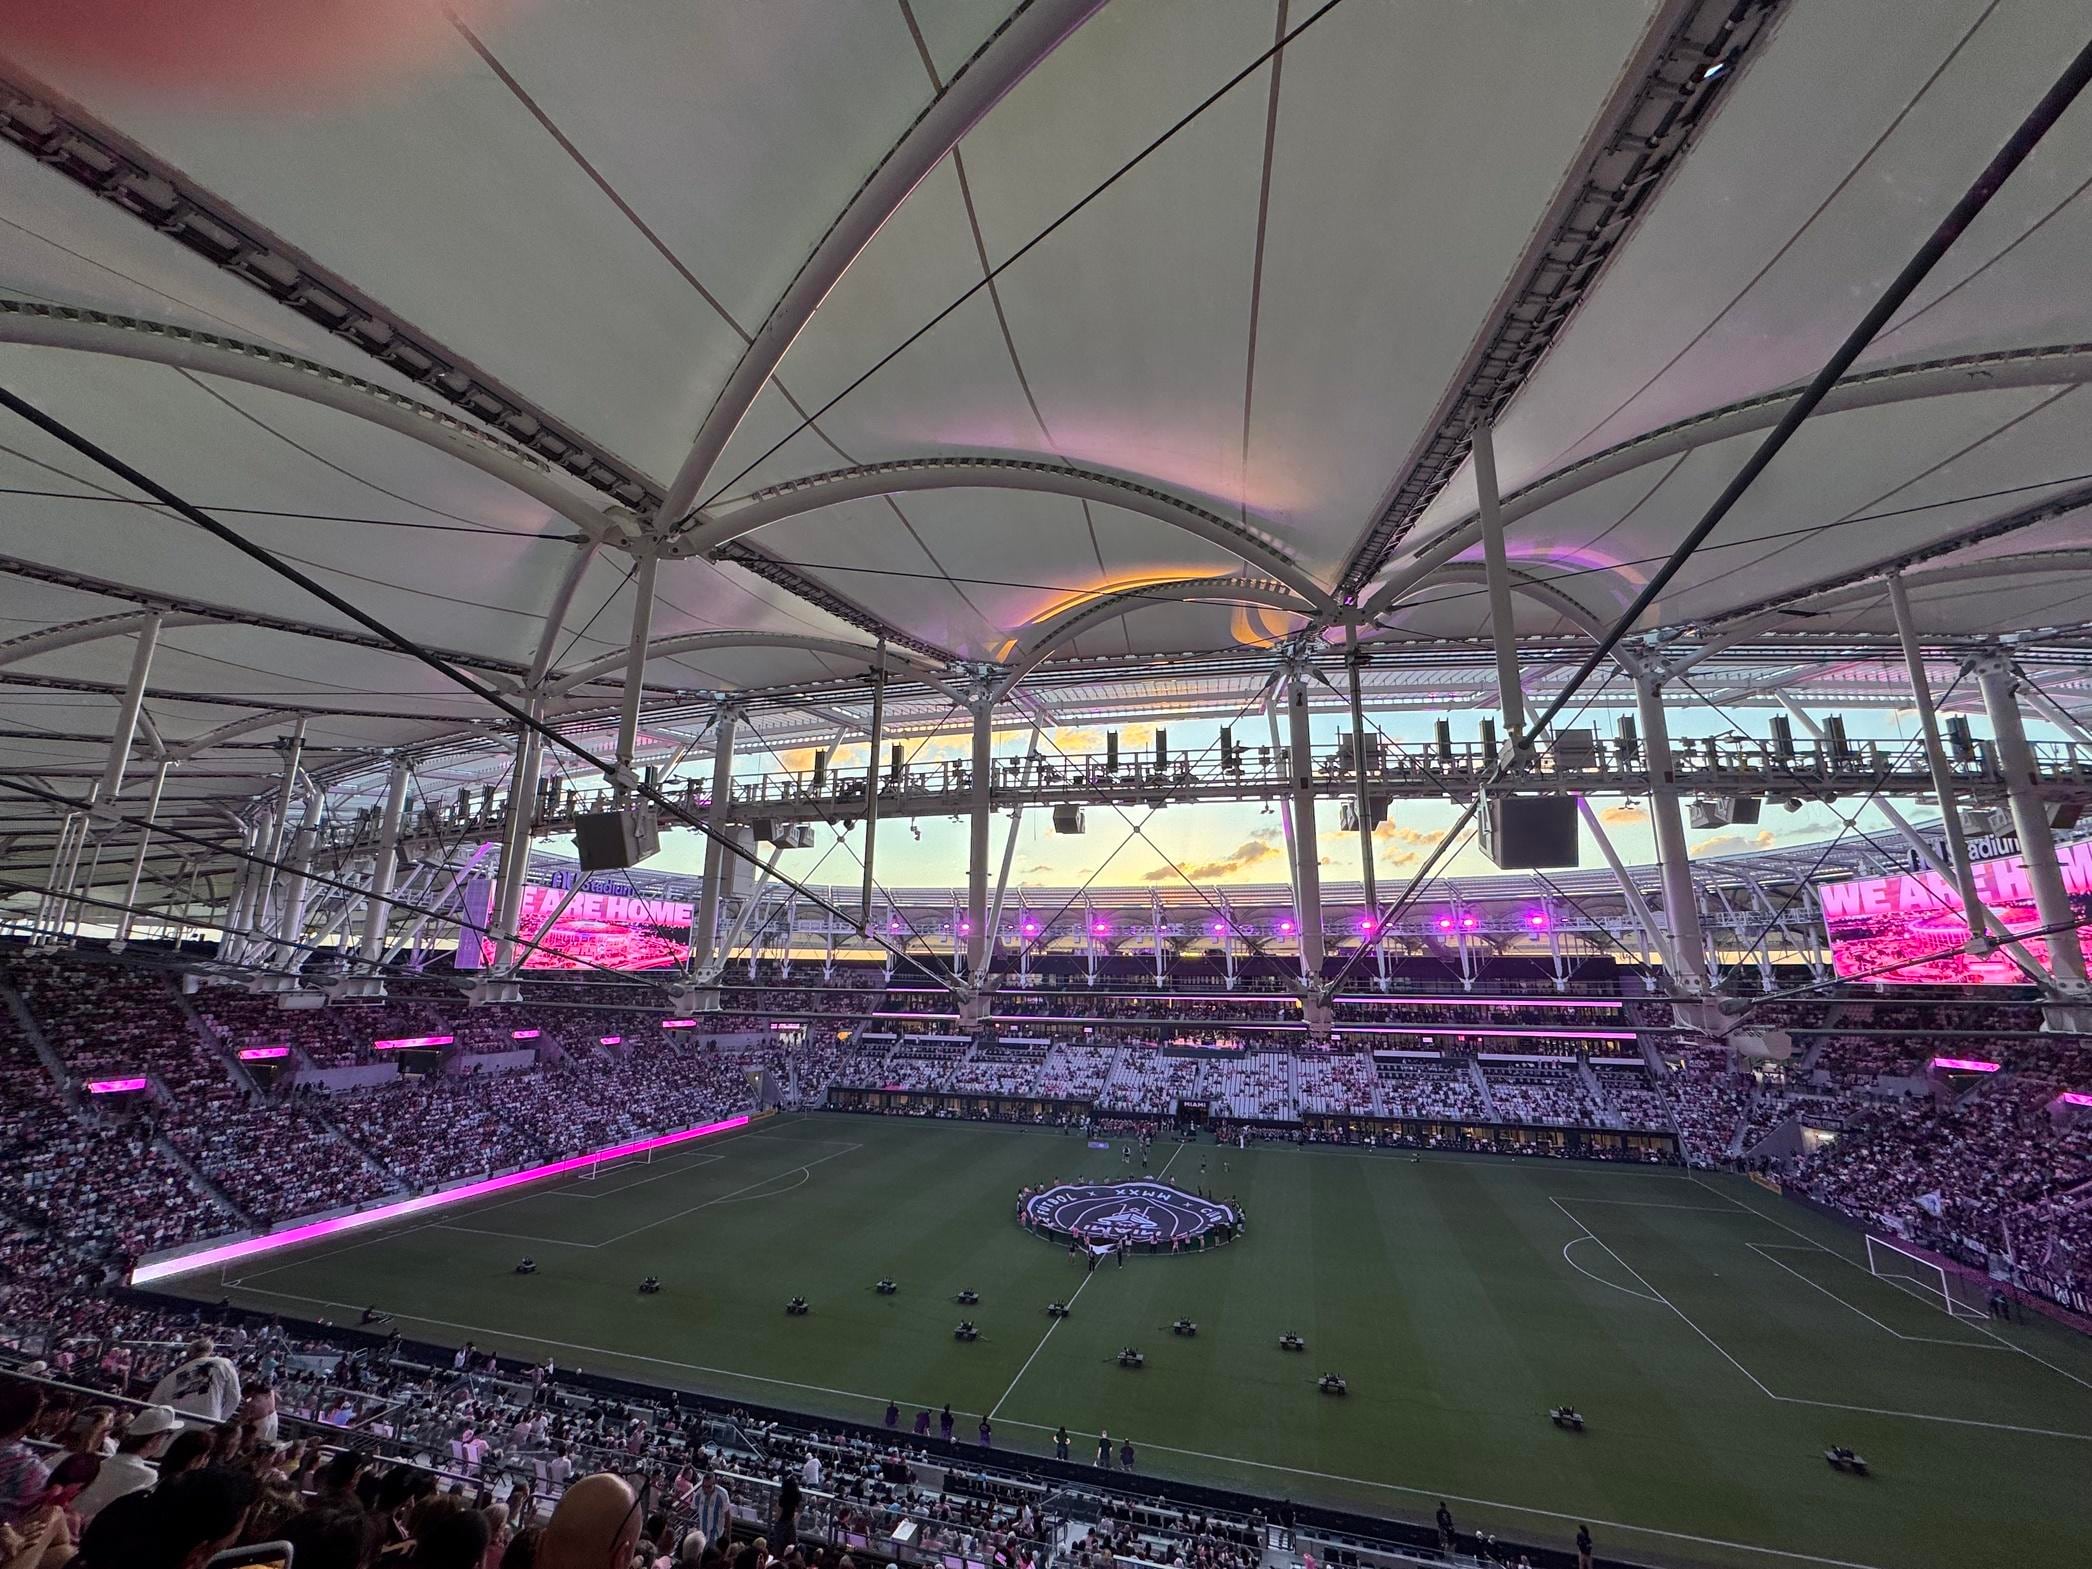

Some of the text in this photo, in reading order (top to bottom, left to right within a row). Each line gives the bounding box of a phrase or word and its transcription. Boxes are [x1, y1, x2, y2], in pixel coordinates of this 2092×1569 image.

[581, 879, 635, 898] Stadium
[1821, 881, 1887, 915] WE
[539, 889, 603, 919] ARE
[613, 895, 693, 923] HOME
